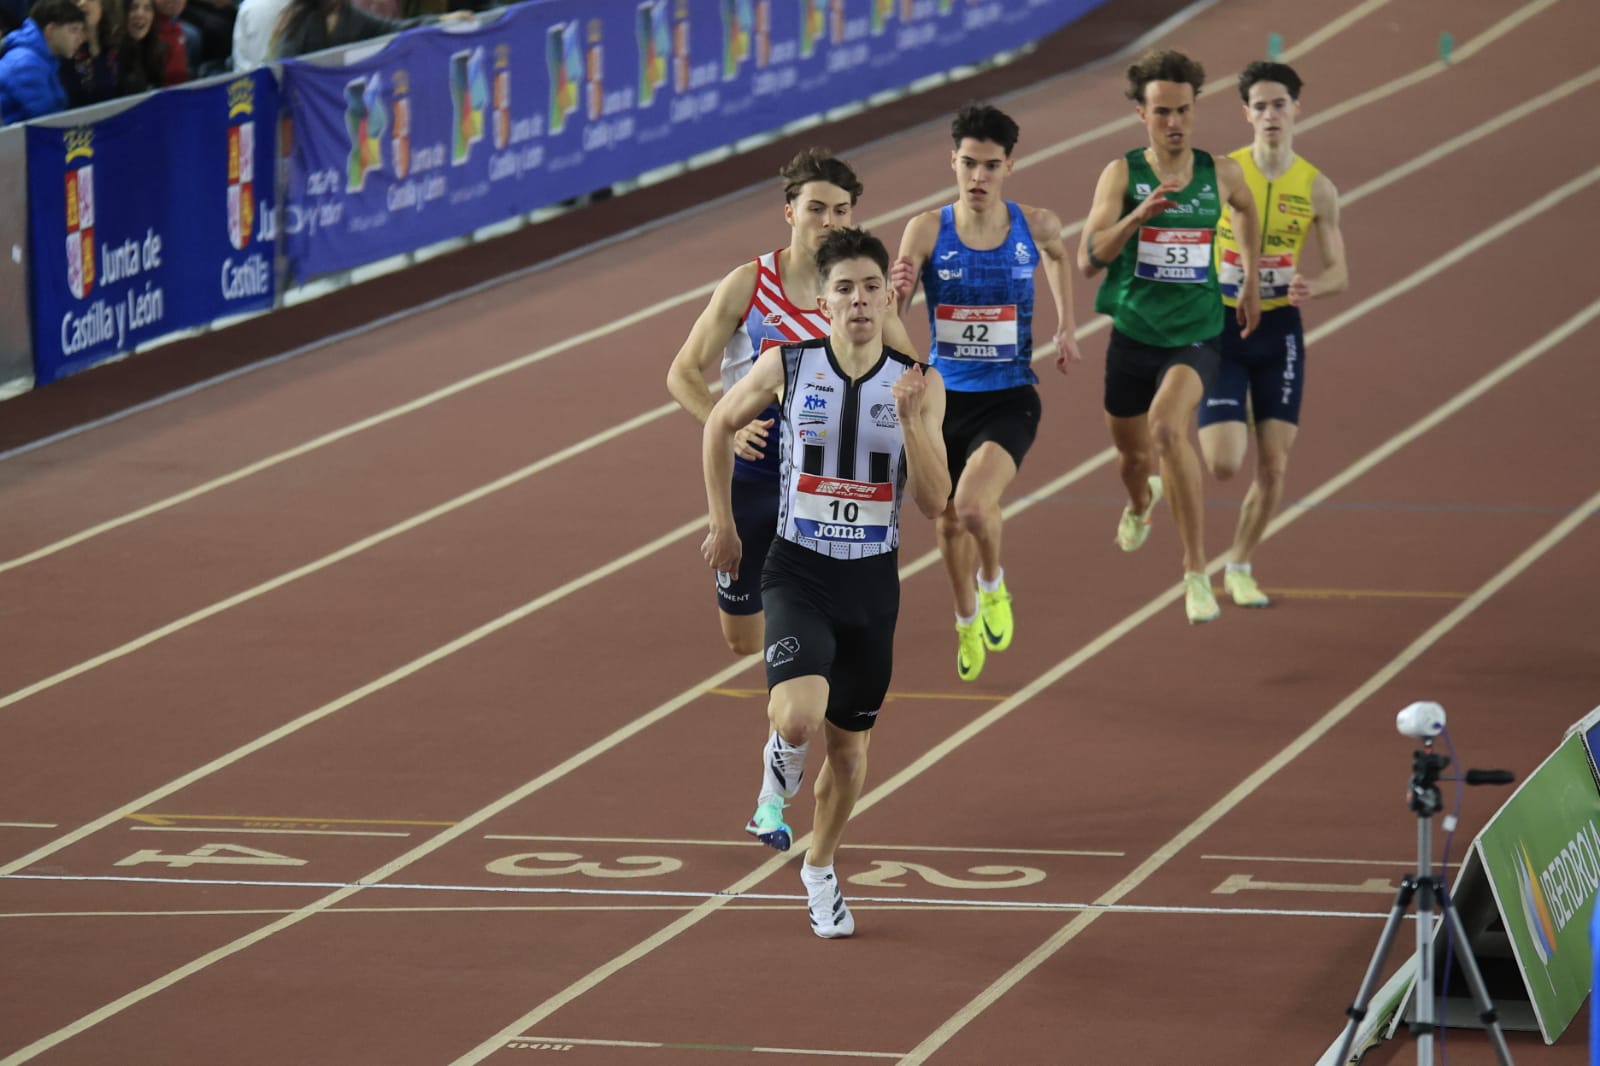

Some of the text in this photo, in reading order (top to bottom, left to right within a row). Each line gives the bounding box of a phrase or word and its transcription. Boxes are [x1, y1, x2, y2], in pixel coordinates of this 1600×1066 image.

[99, 227, 162, 287] Junta de
[1165, 246, 1189, 265] 53
[61, 280, 164, 357] Castilla y León
[961, 324, 990, 342] 42
[829, 500, 859, 523] 10
[113, 842, 310, 868] 4
[484, 852, 683, 879] 3
[847, 860, 1048, 890] 2
[1210, 874, 1400, 894] 1
